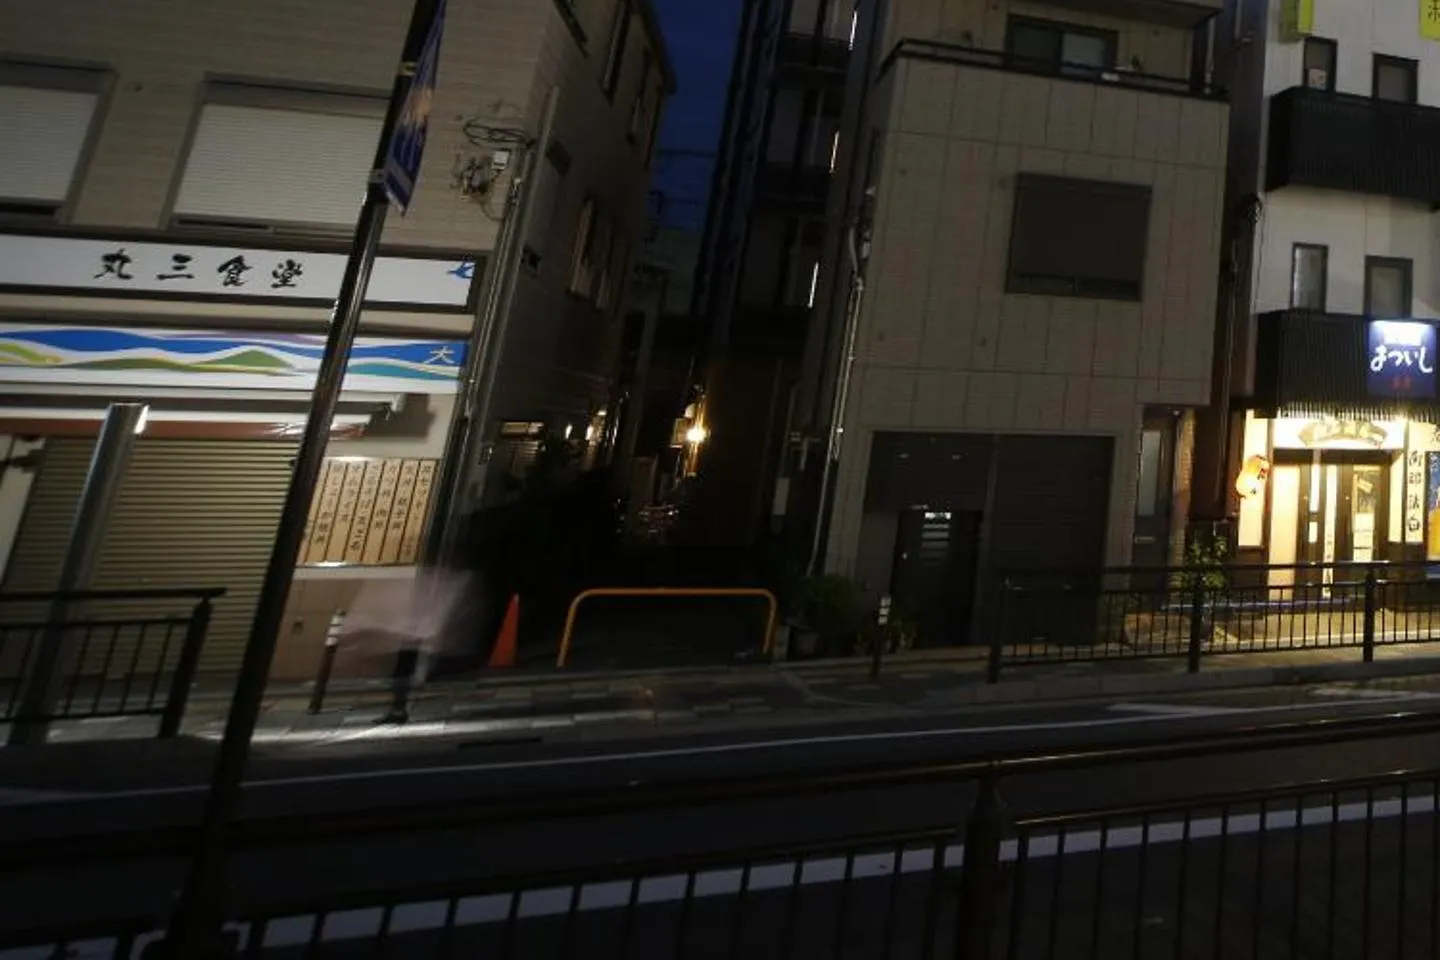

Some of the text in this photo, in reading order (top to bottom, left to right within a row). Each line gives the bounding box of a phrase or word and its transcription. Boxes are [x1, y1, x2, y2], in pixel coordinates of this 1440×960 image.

[94, 248, 303, 289] 丸三食堂
[423, 345, 454, 364] 大
